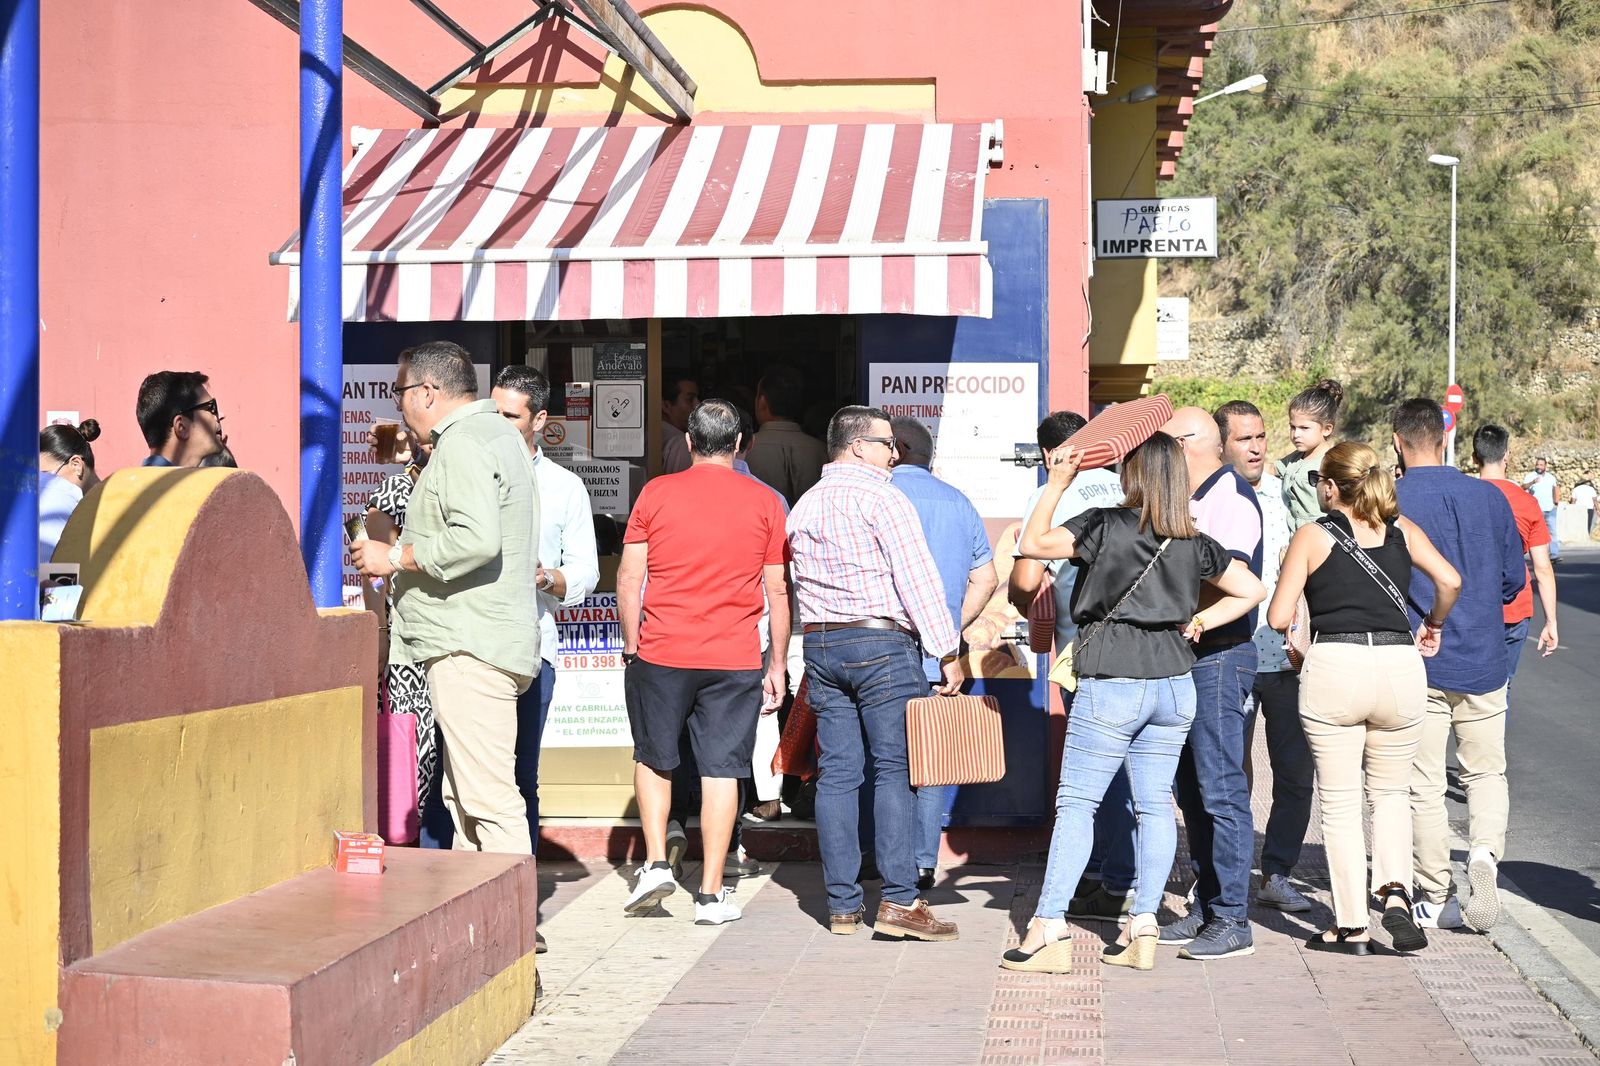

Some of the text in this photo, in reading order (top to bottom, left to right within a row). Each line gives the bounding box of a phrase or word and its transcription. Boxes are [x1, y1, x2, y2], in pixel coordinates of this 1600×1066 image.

[1102, 238, 1208, 254] IMPRENTA
[343, 382, 365, 399] AN
[881, 376, 1025, 394] PAN PRECOCIDO
[343, 471, 386, 485] HAPATAS
[581, 478, 620, 486] TARJETAS
[593, 489, 618, 497] BIZUM
[1078, 484, 1109, 501] BORN
[557, 624, 587, 649] ENTA
[589, 624, 604, 649] DE
[564, 655, 588, 669] 610
[592, 655, 616, 668] 398
[554, 704, 626, 712] HAY CABRILLAS
[554, 716, 586, 724] HABAS
[588, 716, 628, 724] ENZAPAT
[563, 728, 574, 736] EL
